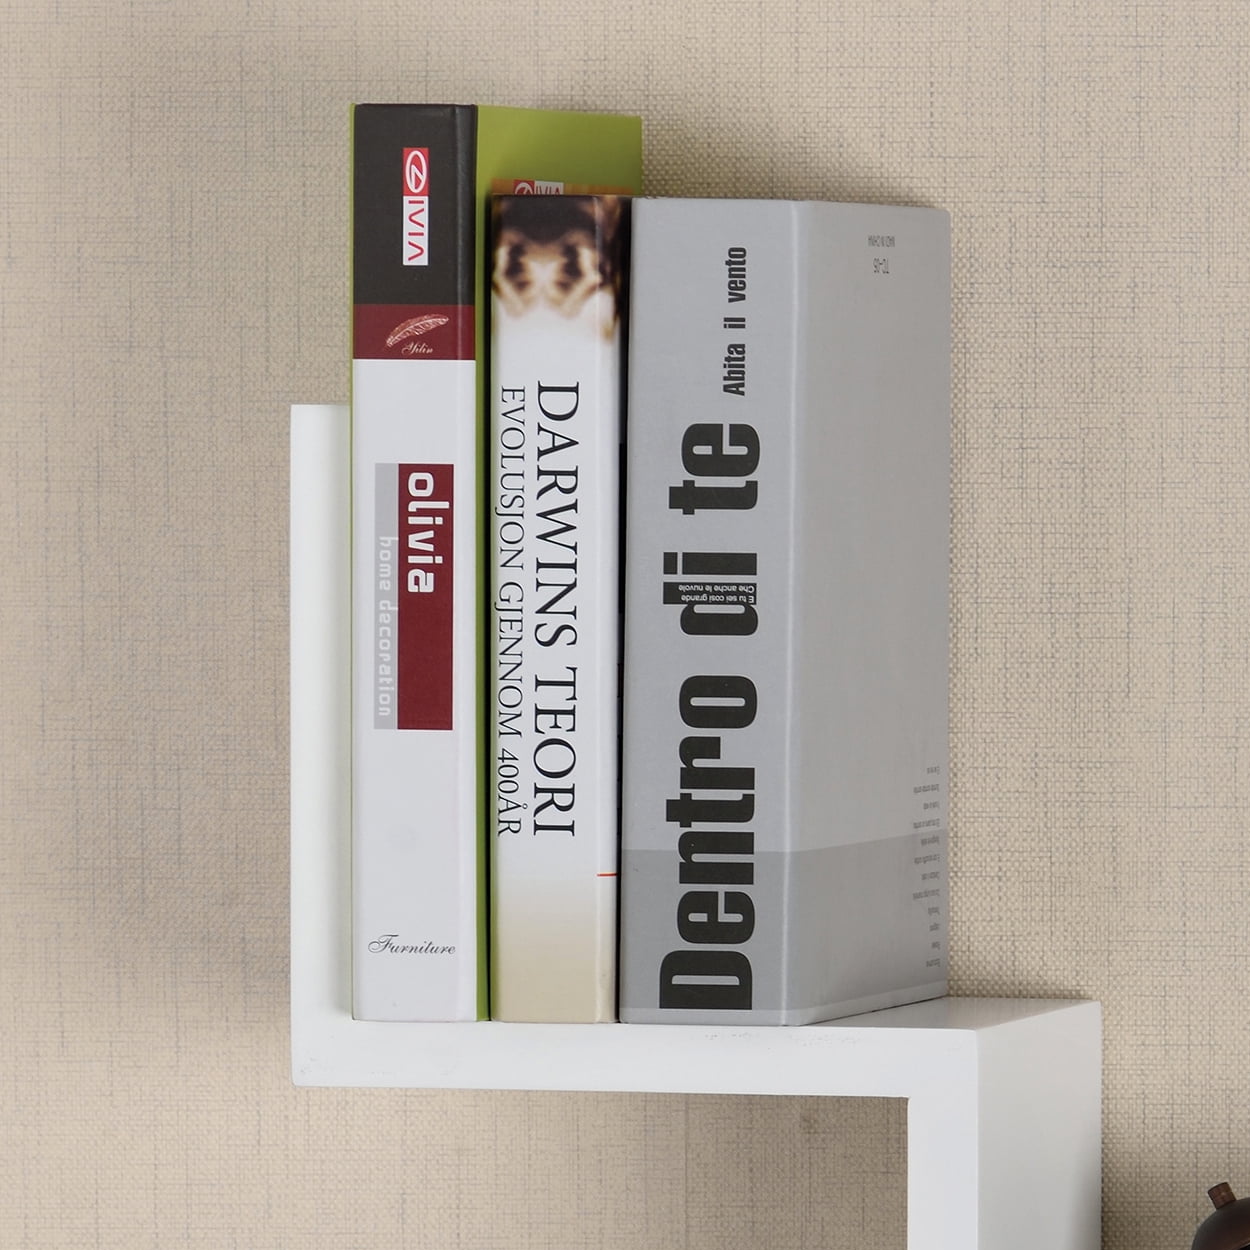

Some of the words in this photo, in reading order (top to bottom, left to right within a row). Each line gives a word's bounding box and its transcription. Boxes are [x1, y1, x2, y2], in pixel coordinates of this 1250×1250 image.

[725, 246, 748, 303] vento
[723, 316, 747, 330] il
[722, 343, 746, 397] Abita
[494, 386, 526, 570] EVOLUSJON
[668, 422, 761, 515] te
[407, 471, 450, 594] olivia
[534, 381, 580, 648] DARWINS
[378, 536, 399, 592] home
[662, 551, 759, 637] di
[678, 584, 704, 593] nuvole
[680, 593, 708, 603] grande
[704, 585, 712, 593] le
[713, 585, 738, 593] anche
[738, 585, 755, 594] Che
[378, 600, 399, 716] decoration
[494, 581, 524, 738] GJENNOM
[532, 666, 579, 837] TEORI
[496, 747, 528, 837] 400ÅR
[658, 674, 759, 1011] Dentro
[367, 933, 457, 956] Furniture
